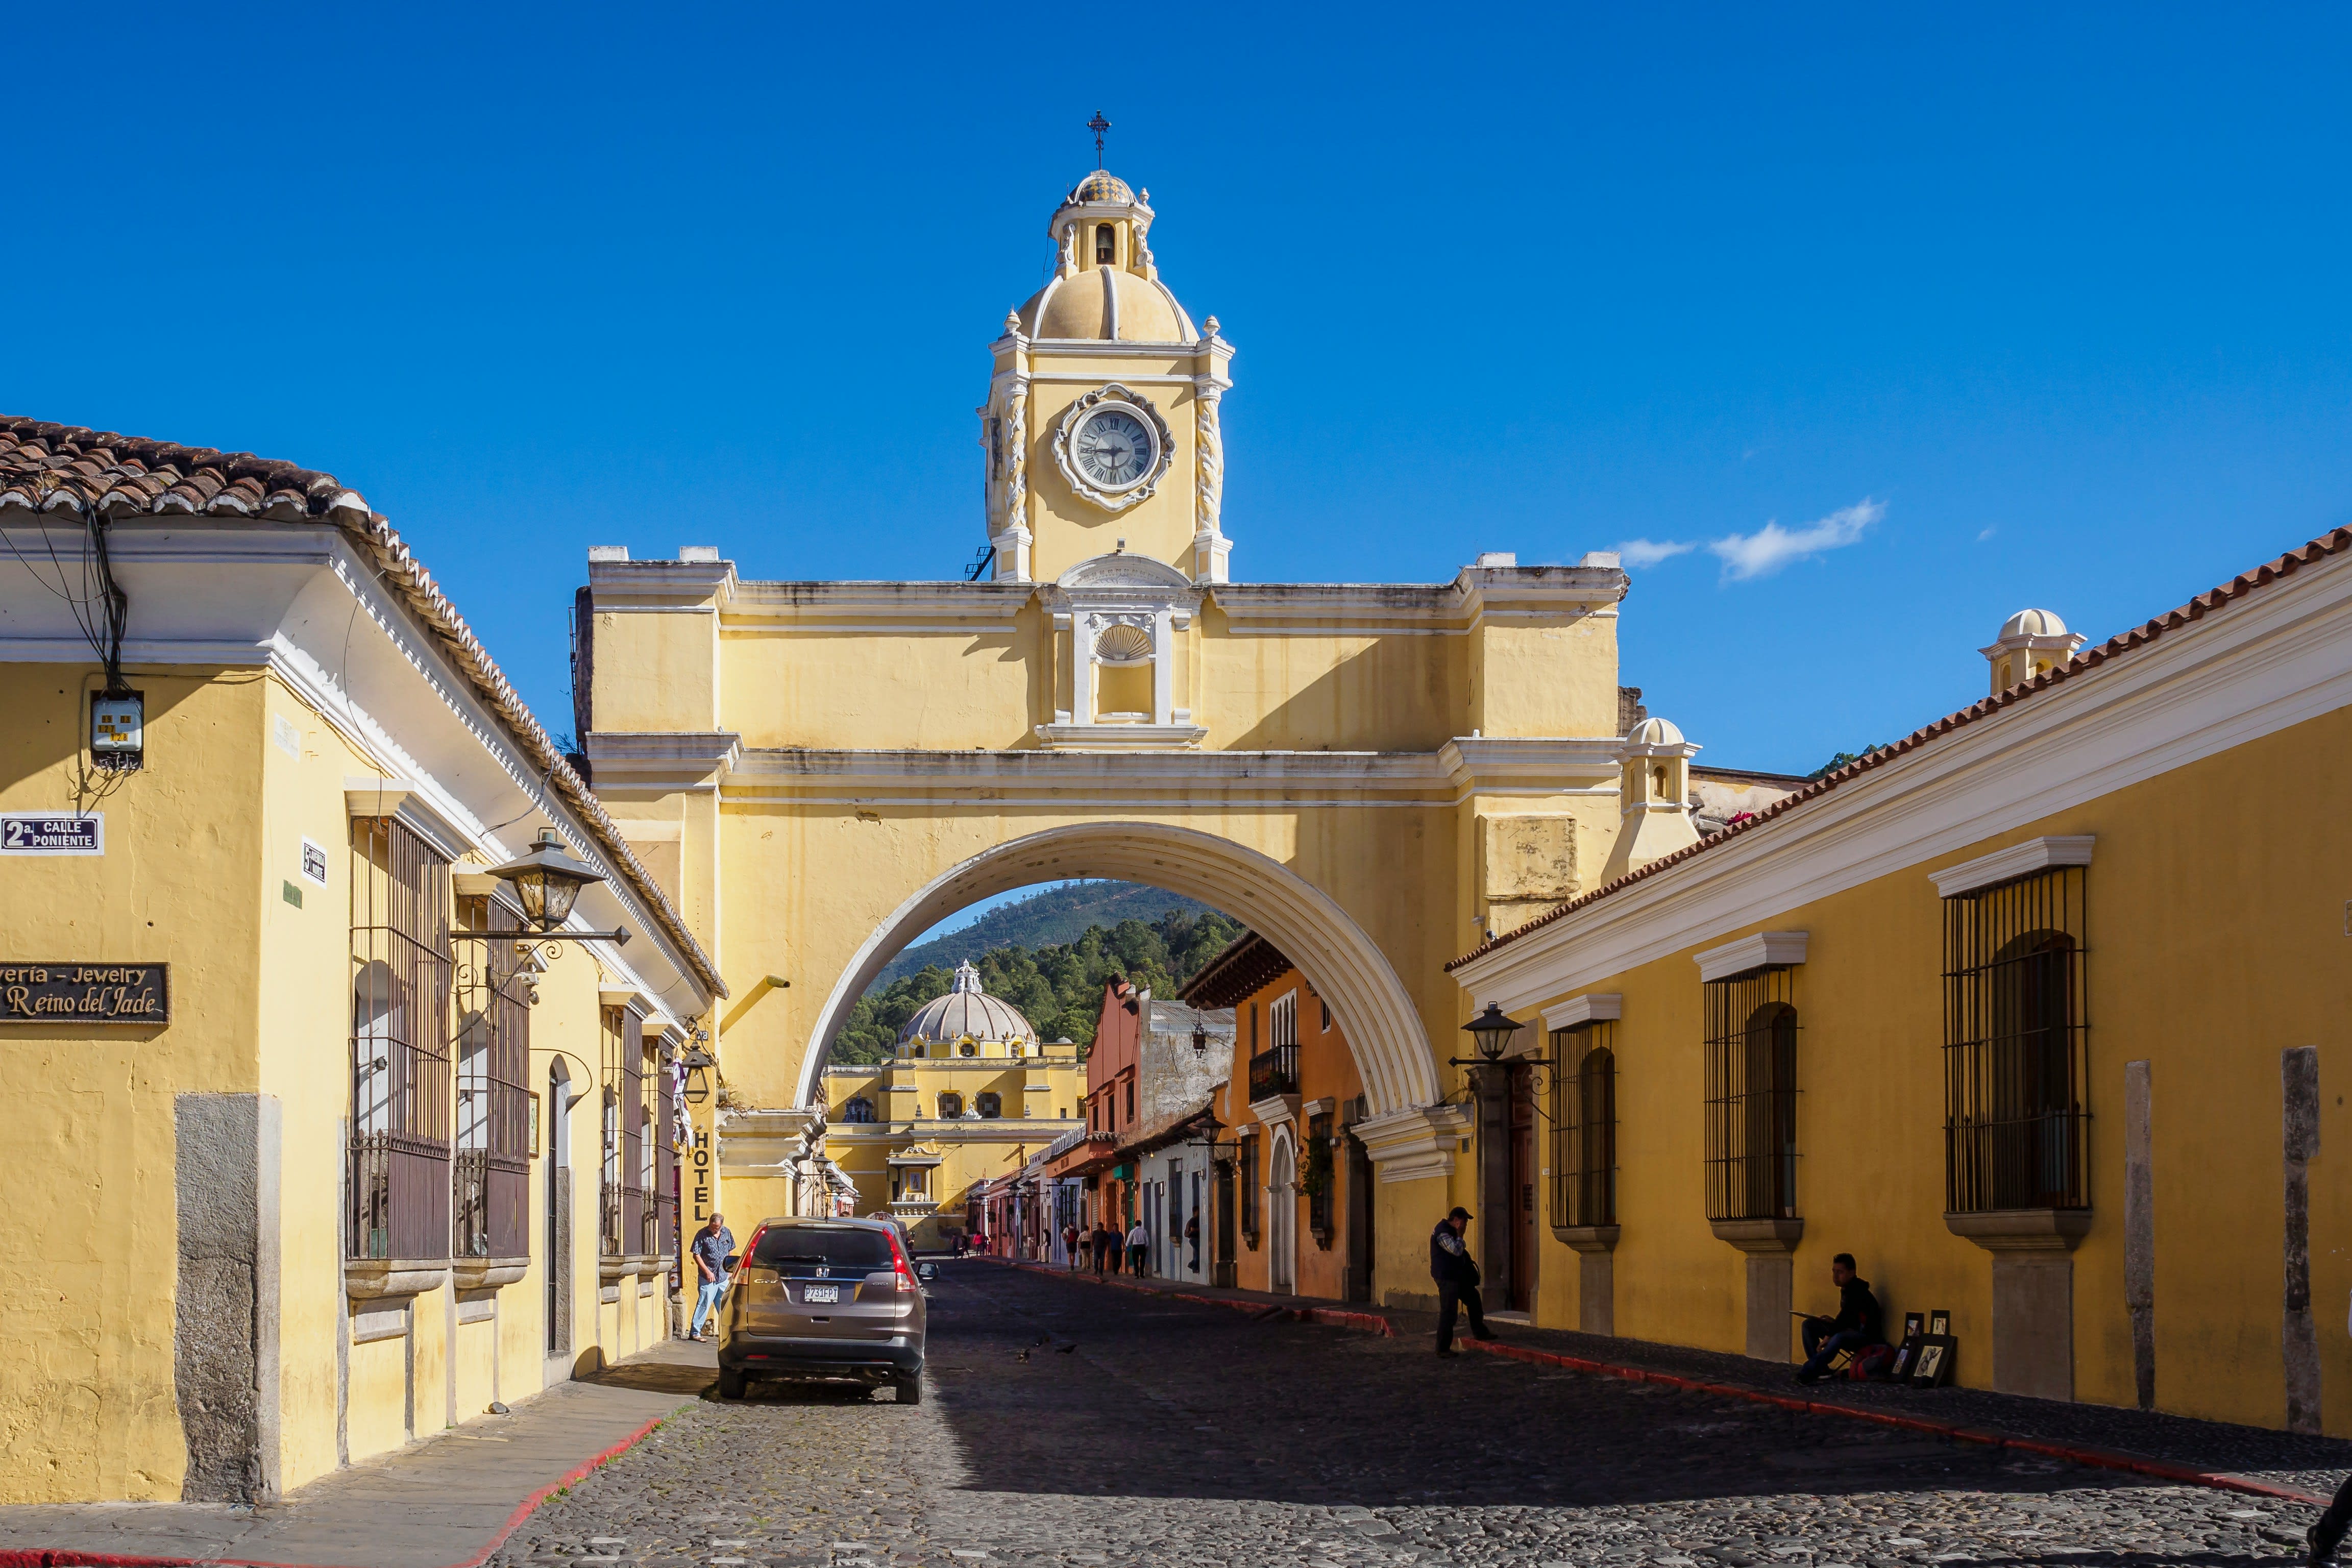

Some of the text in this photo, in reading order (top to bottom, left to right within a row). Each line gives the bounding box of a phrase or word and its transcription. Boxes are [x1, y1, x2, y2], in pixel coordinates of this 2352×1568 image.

[1095, 421, 1107, 434] XI
[1109, 419, 1120, 430] XII
[1131, 433, 1143, 443] II
[44, 822, 82, 832] CALLE
[34, 835, 92, 846] PONIENTE
[0, 966, 47, 982] ería
[72, 968, 146, 986] Jewelry
[7, 986, 155, 1016] Reino del Jade
[694, 1133, 708, 1221] HOTEL
[806, 1288, 838, 1297] P731FPT
